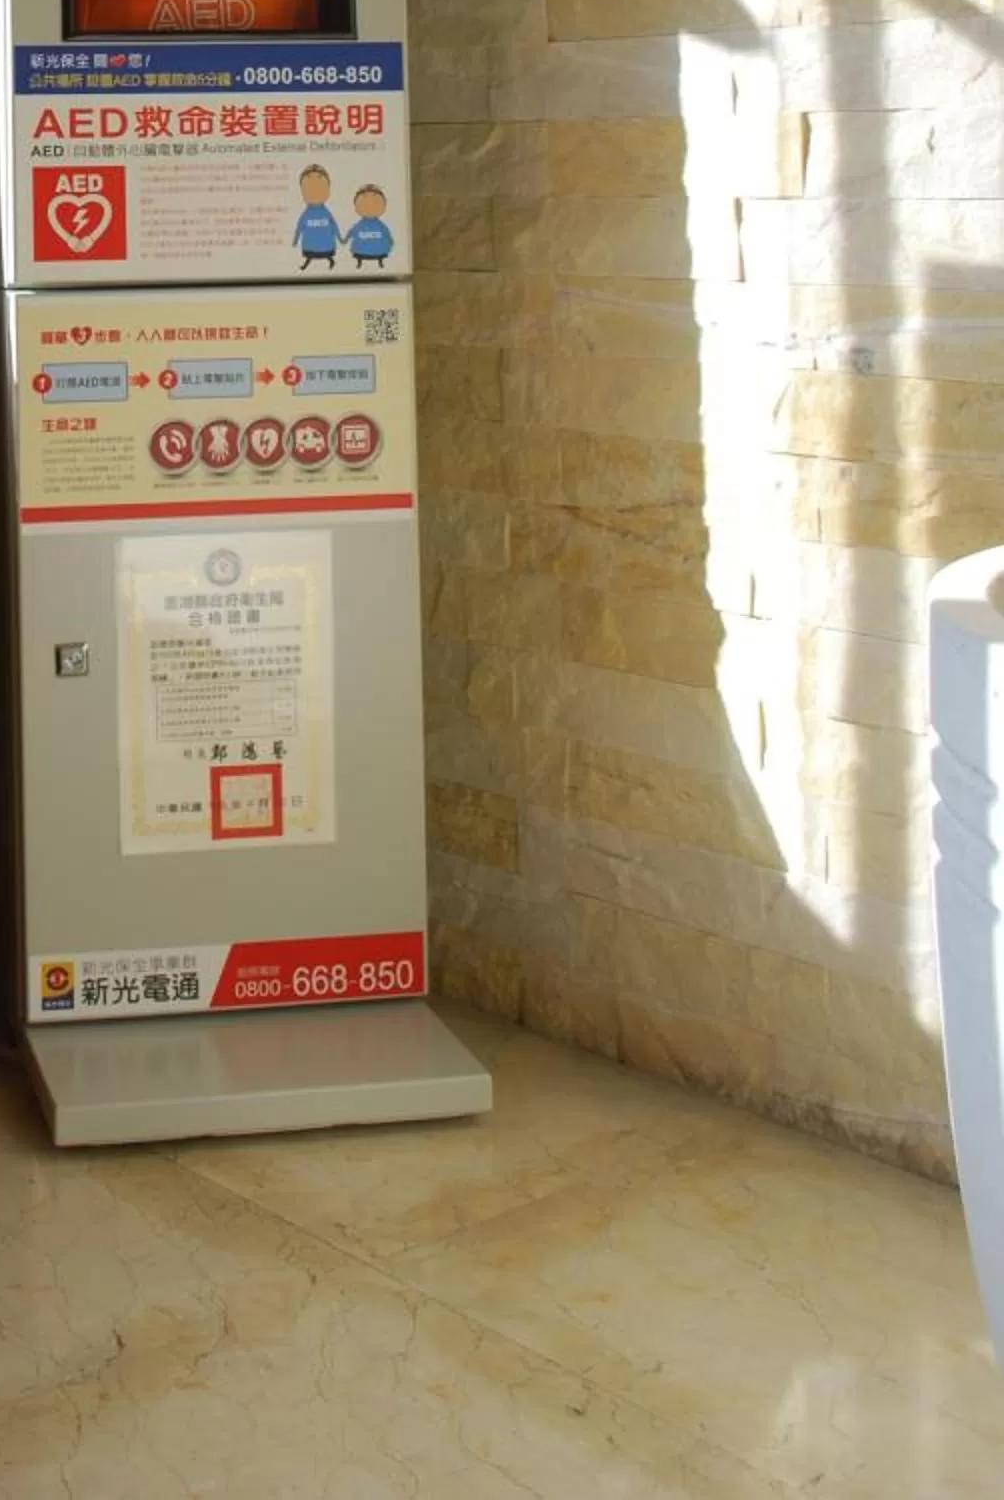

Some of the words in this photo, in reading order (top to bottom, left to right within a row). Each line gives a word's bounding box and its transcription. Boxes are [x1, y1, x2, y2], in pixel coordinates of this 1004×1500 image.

[243, 65, 383, 85] 0800-668-850
[32, 103, 384, 140] AED救命裝置說明
[30, 144, 65, 158] AED
[55, 172, 104, 193] AED
[80, 971, 200, 1006] 新光電通
